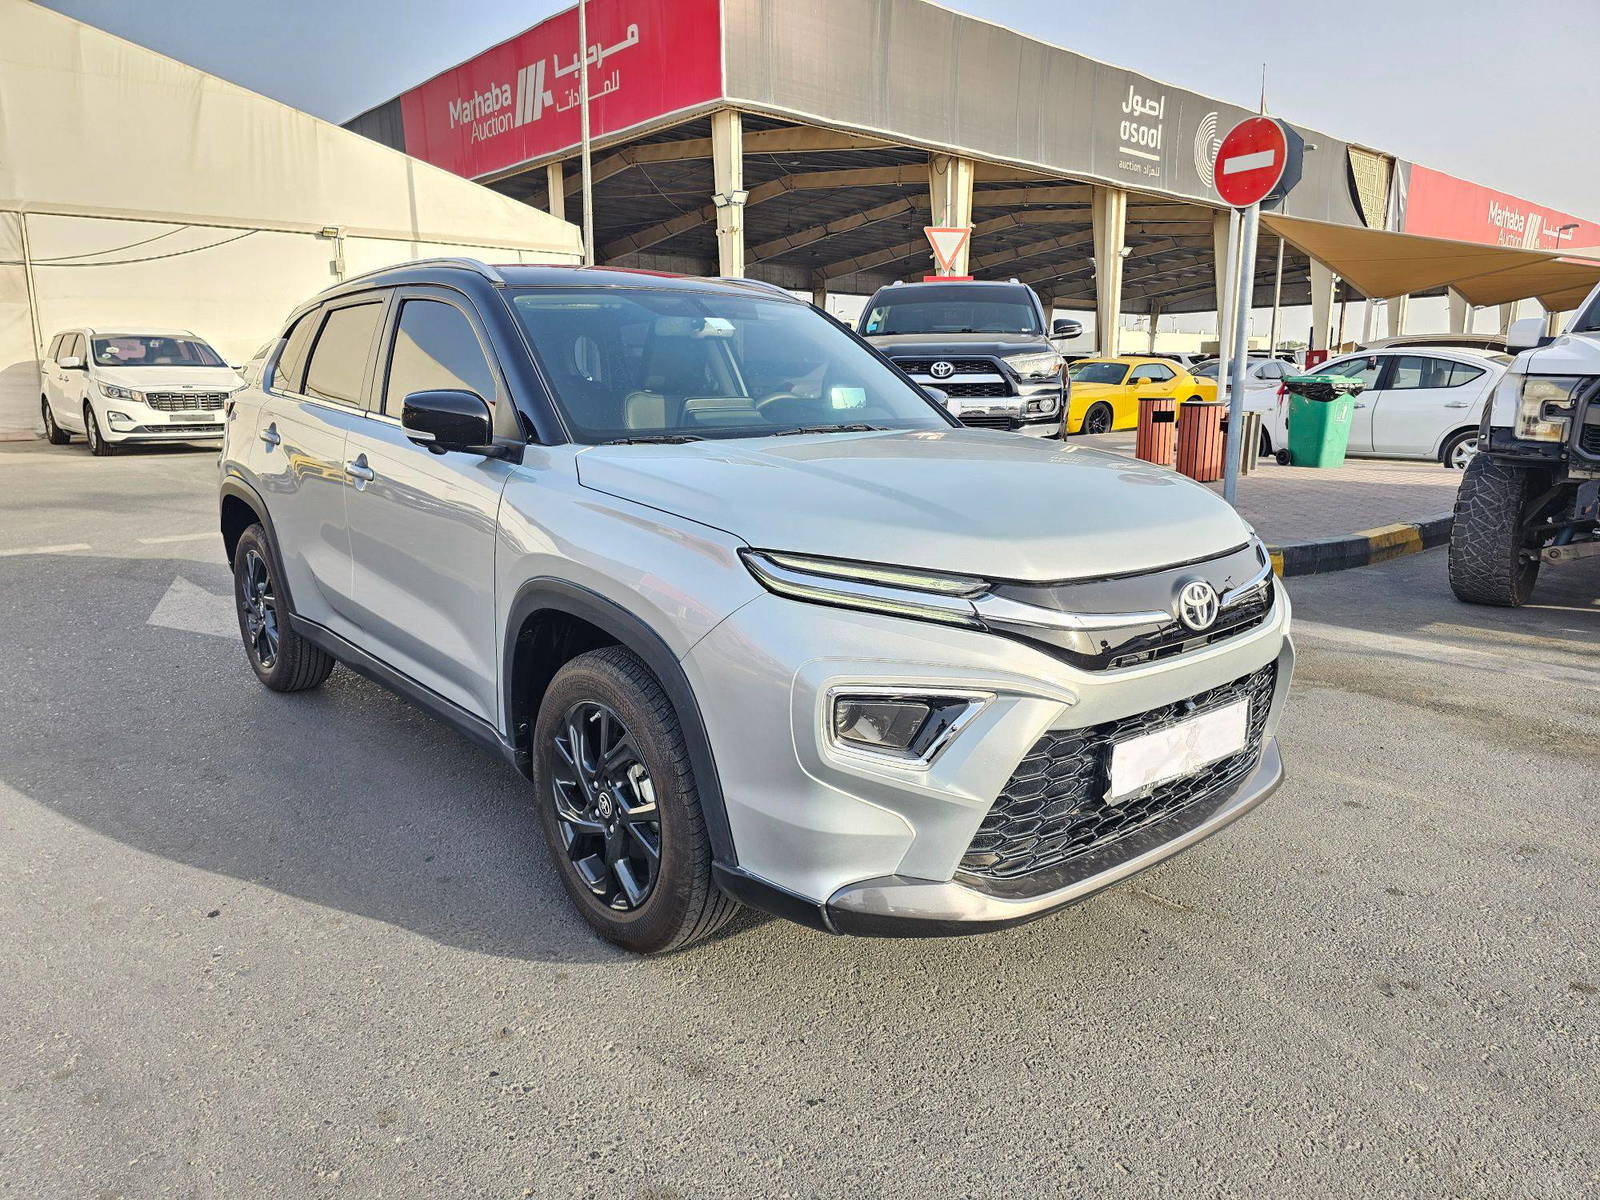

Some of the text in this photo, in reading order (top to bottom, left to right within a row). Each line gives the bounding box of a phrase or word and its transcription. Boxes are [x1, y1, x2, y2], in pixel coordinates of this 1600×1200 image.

[449, 82, 512, 130] Marhaba
[470, 111, 514, 145] Auction
[1118, 160, 1141, 173] auction
[1487, 199, 1525, 232] Marhaba
